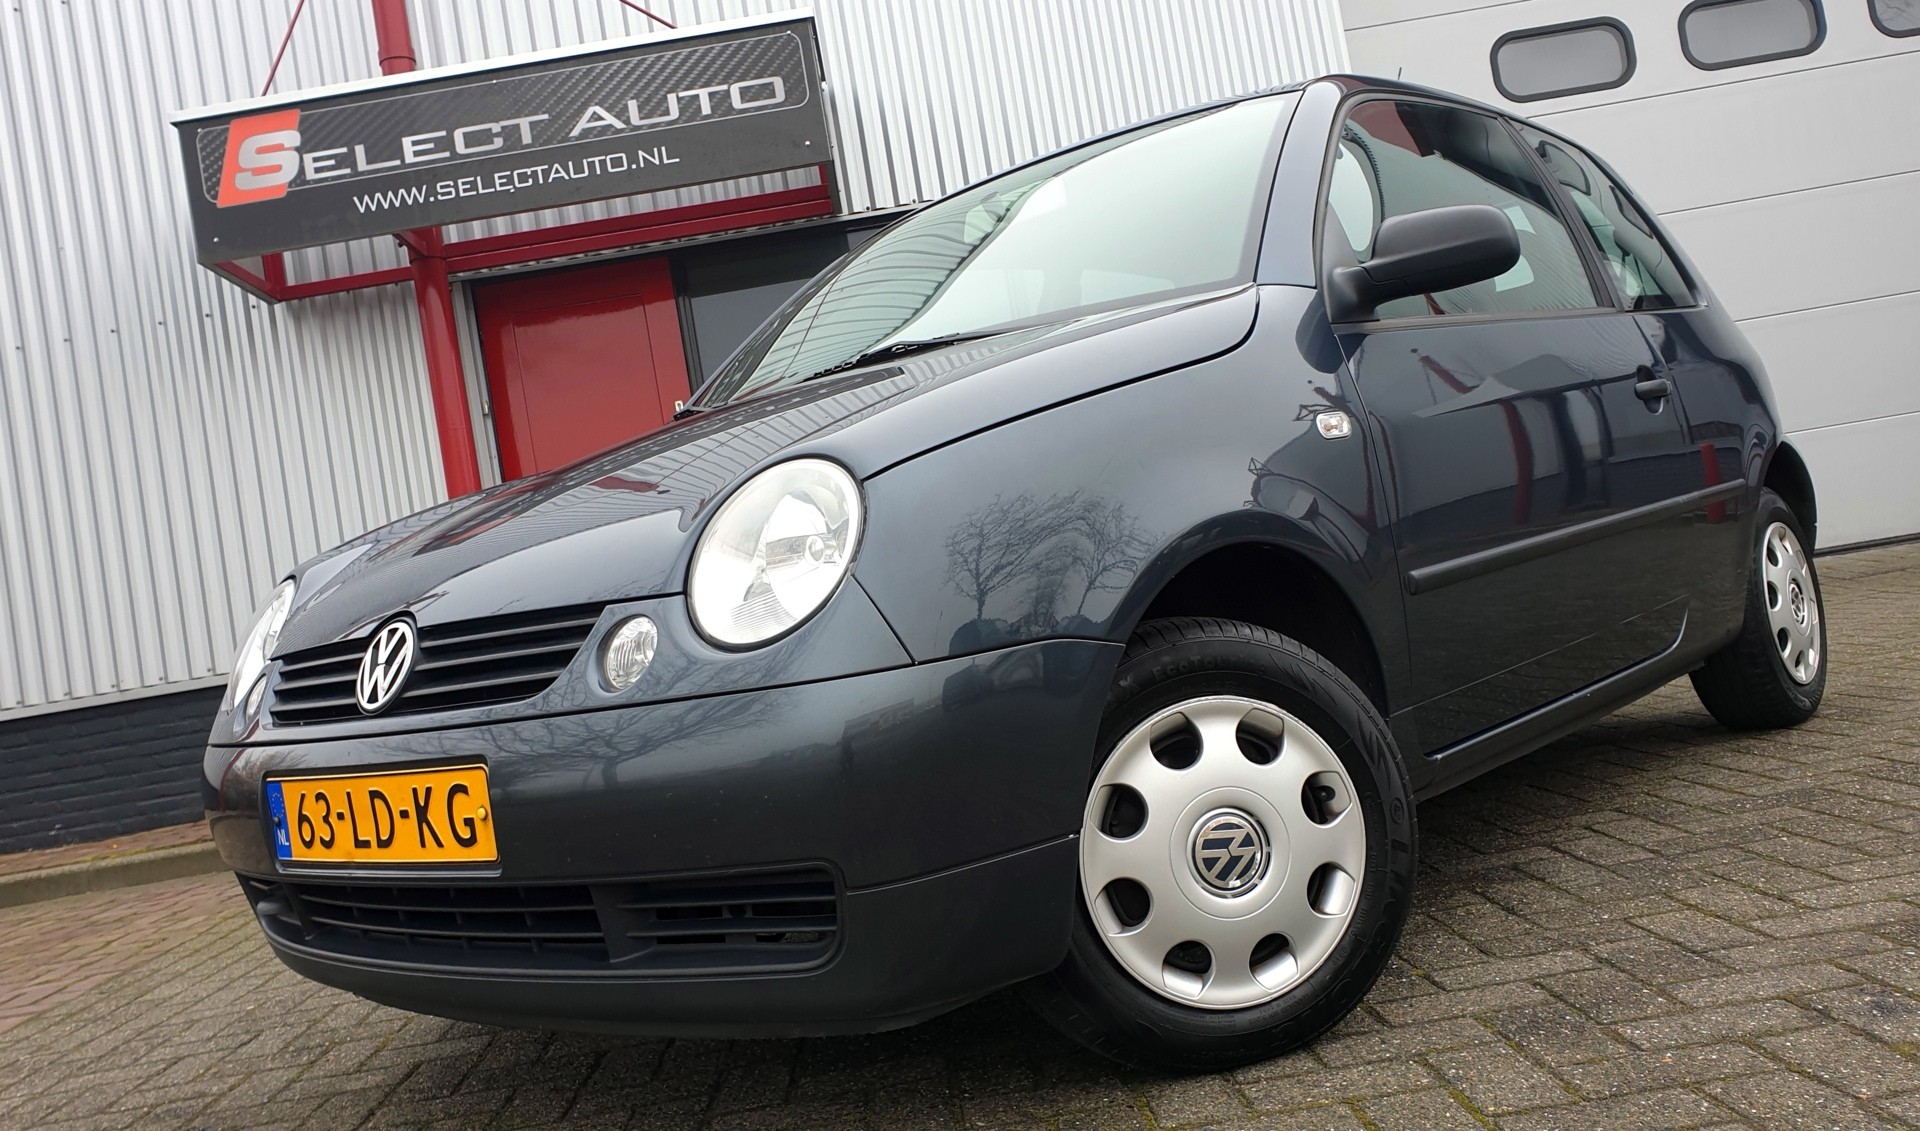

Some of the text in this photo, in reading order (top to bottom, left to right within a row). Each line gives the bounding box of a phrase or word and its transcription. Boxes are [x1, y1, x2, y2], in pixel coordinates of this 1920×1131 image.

[568, 75, 787, 138] AUTO
[352, 145, 681, 214] WWW.SELECTAUTO.NL
[276, 828, 291, 847] NL
[296, 782, 479, 851] 63-LD-KG
